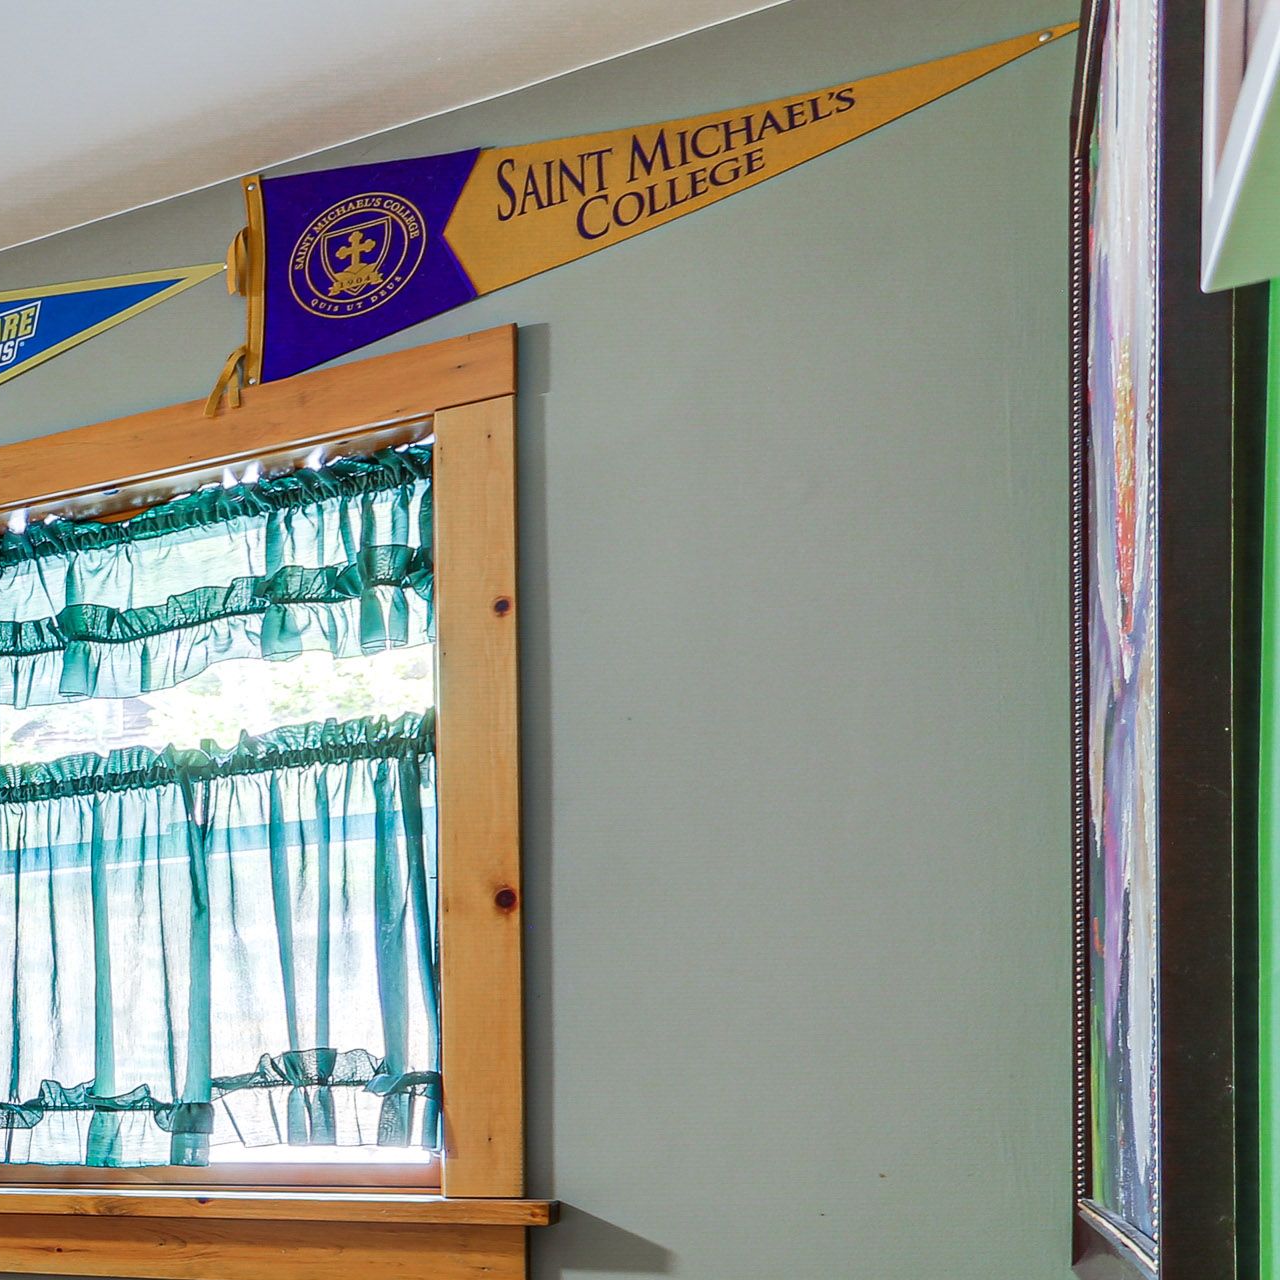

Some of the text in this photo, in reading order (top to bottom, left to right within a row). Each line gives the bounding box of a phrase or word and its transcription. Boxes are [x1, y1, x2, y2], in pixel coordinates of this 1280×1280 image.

[496, 87, 856, 222] SAINT MICHAEL'S
[576, 148, 766, 241] COLLEGE
[294, 197, 420, 270] SAINT MICHAEL'S COLLEGE
[311, 298, 339, 312] QUIS
[347, 301, 363, 311] UT
[339, 274, 371, 288] 1904
